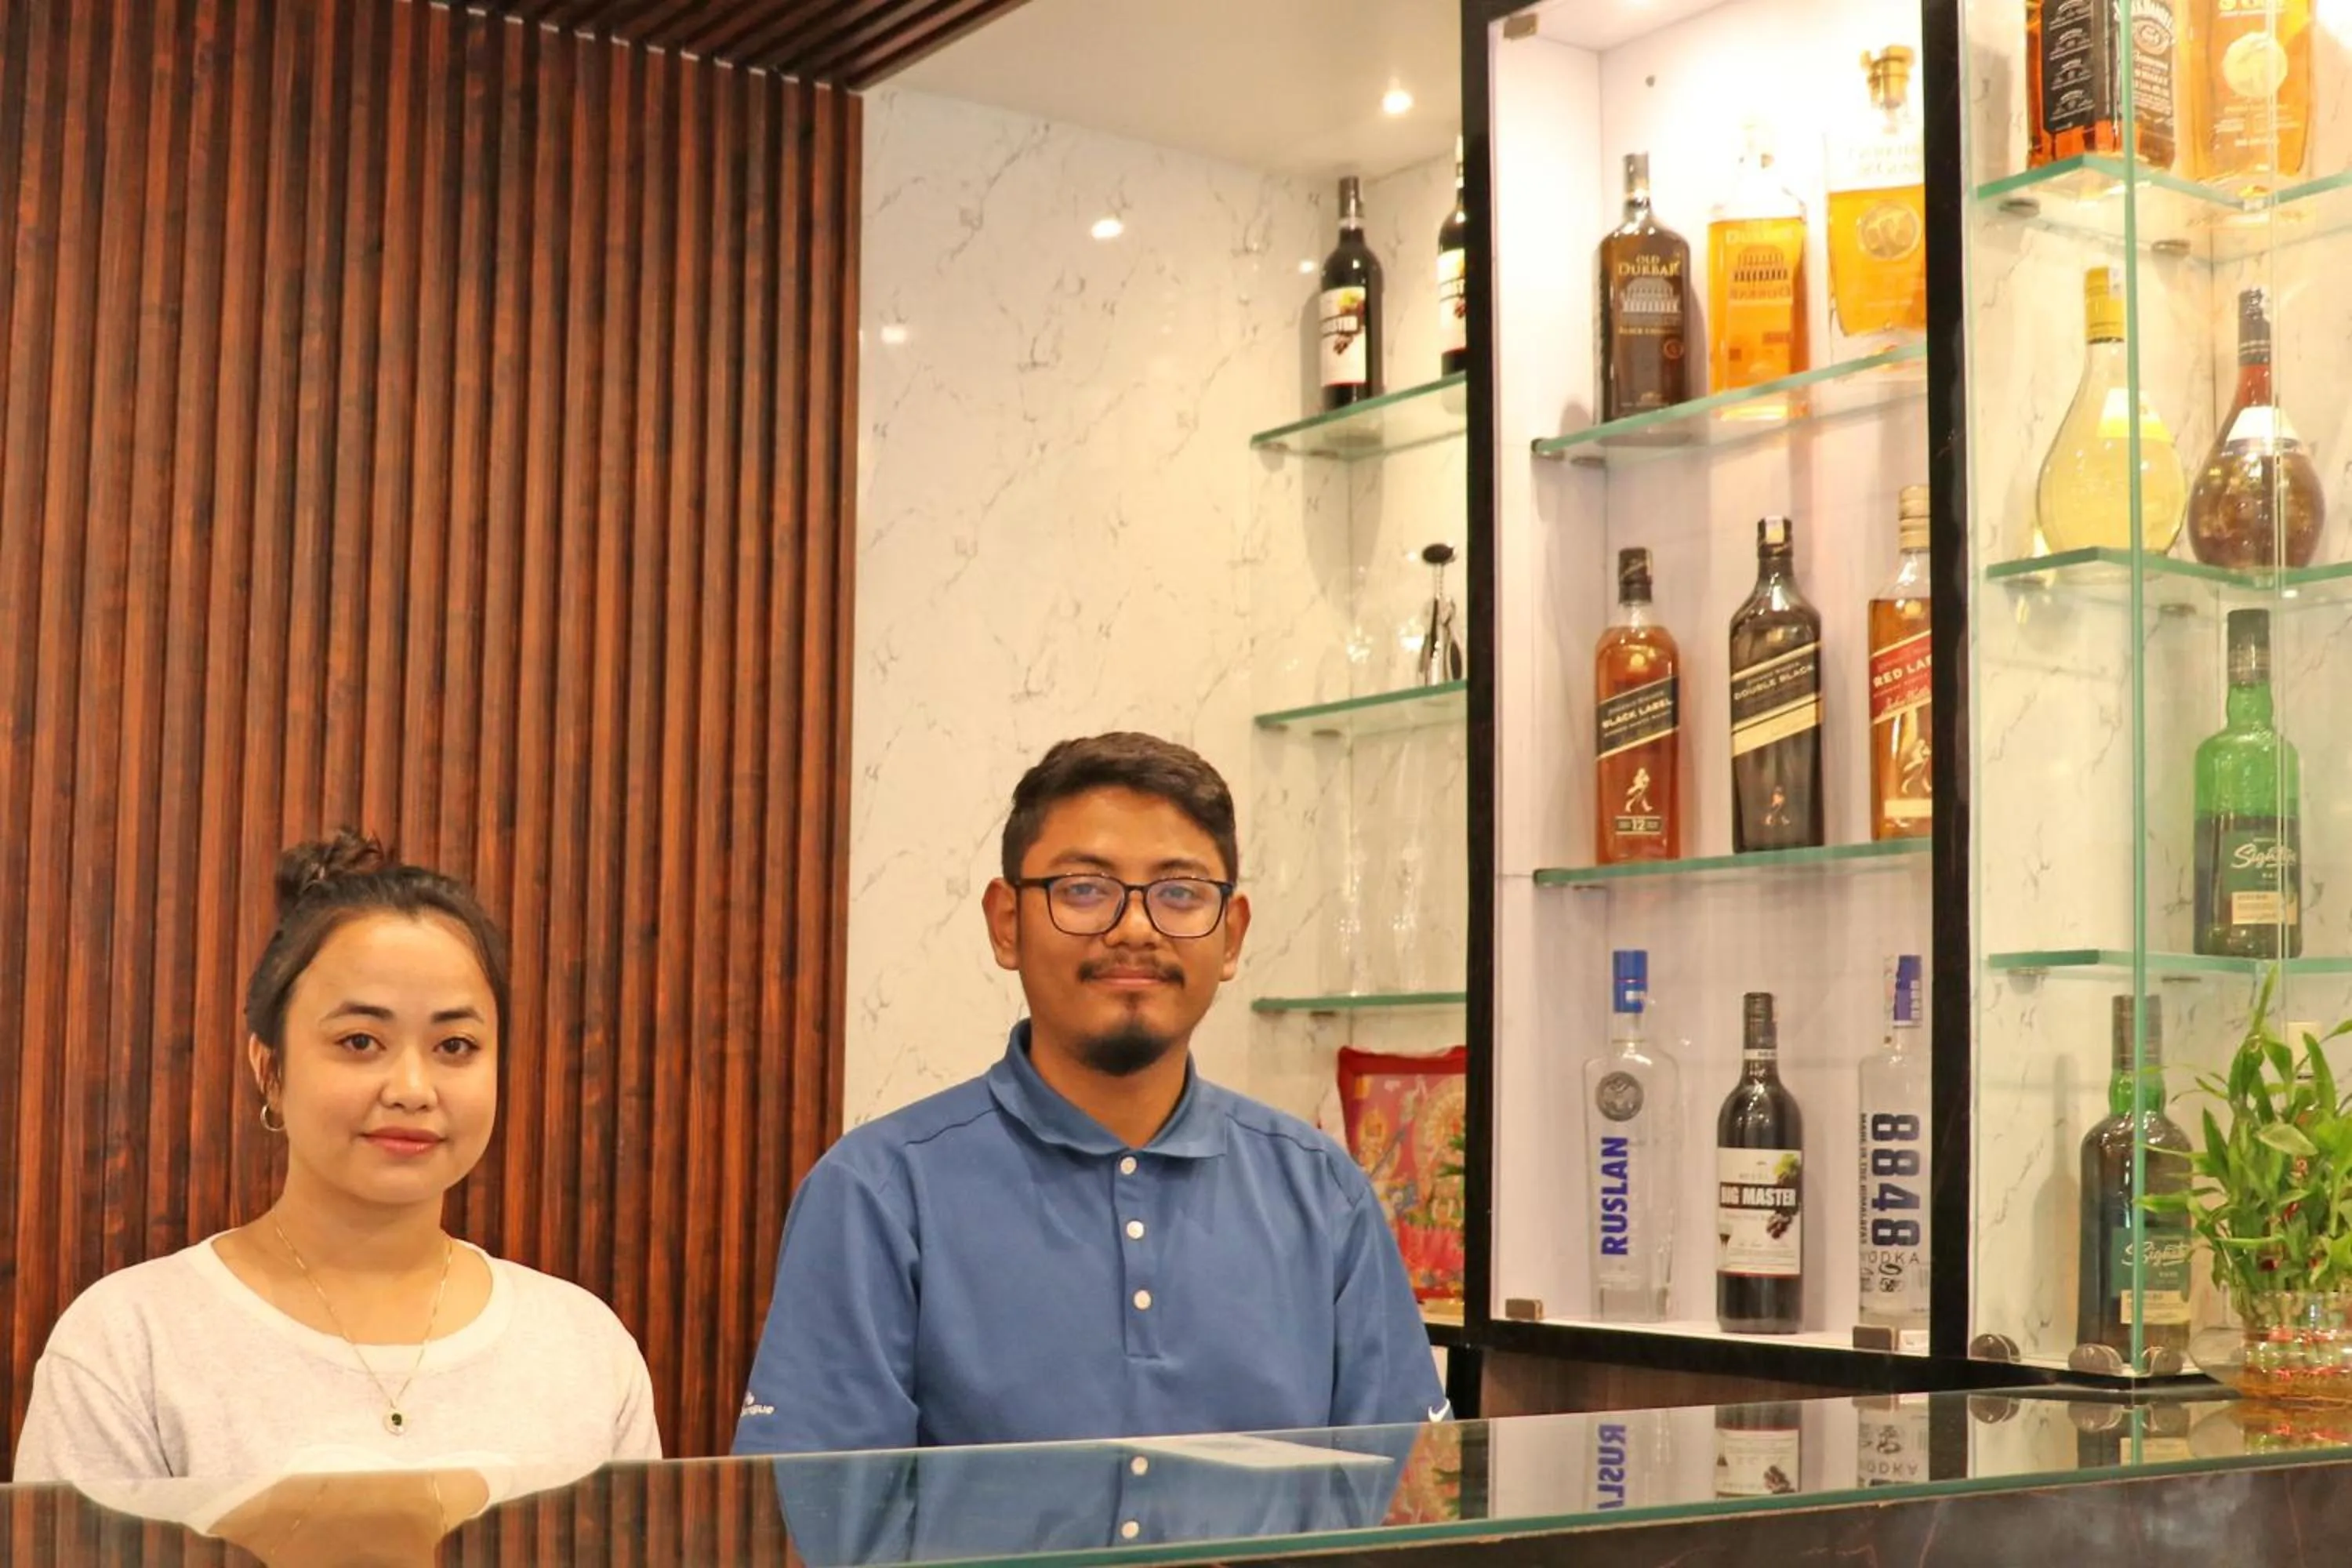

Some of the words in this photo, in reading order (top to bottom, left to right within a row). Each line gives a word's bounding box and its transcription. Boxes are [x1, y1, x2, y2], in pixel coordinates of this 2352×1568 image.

[1617, 260, 1680, 277] DURBAR
[1635, 254, 1661, 264] OLD
[1733, 677, 1777, 701] DOUBLE
[1778, 664, 1814, 683] BLACK
[1872, 666, 1904, 688] RED
[1602, 709, 1637, 729] BLACK
[1638, 697, 1674, 716] LABEL
[1632, 818, 1646, 831] 12
[1871, 1112, 1921, 1247] 8848
[1601, 1137, 1628, 1255] RUSLAN
[1741, 1186, 1796, 1207] MASTER
